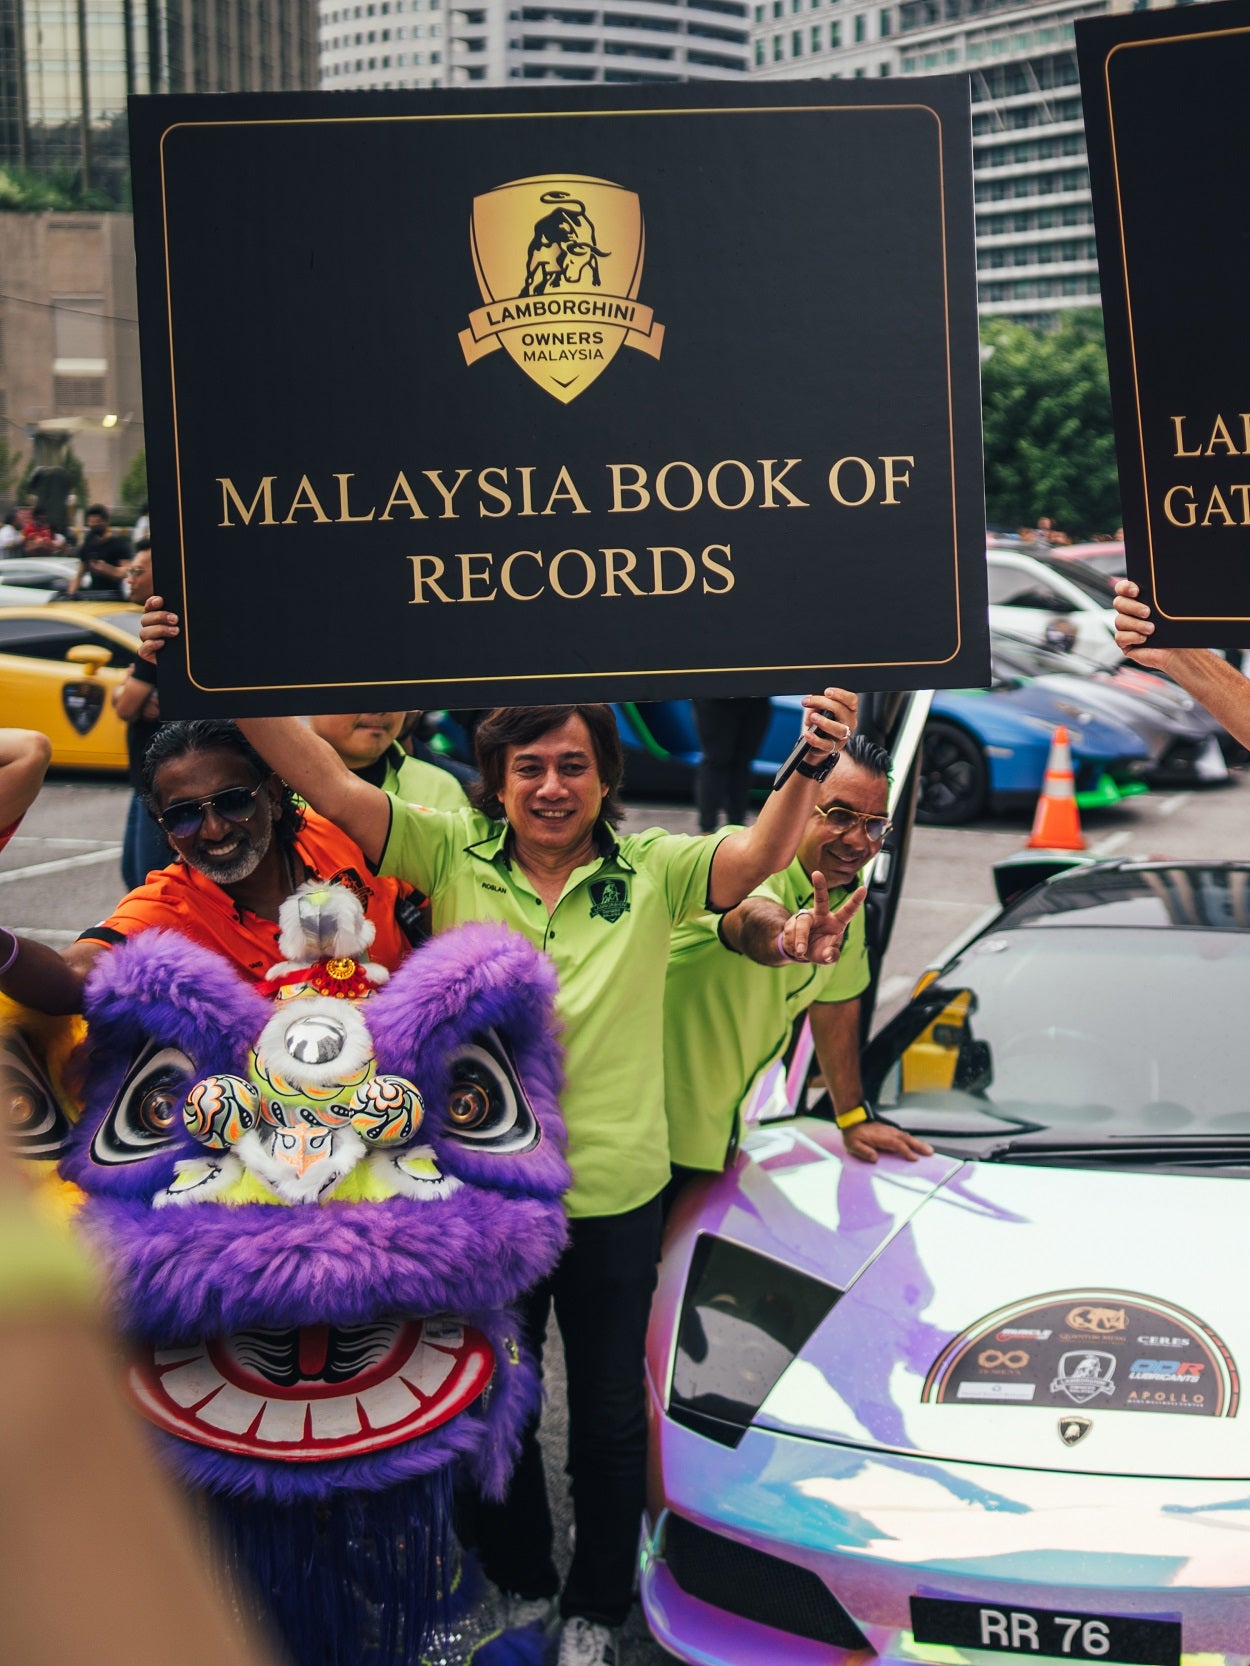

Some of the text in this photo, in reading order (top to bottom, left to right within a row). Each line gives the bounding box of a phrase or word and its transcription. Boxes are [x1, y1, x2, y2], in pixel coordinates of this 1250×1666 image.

[486, 300, 635, 326] LAMBORGHINI
[521, 331, 604, 347] OWNERS
[523, 348, 604, 362] MALAYSIA
[216, 455, 915, 526] MALAYSIA BOOK OF
[407, 544, 735, 604] RECORDS
[1137, 1335, 1190, 1346] CERES
[1128, 1372, 1200, 1383] LUBRICANTS
[1128, 1391, 1204, 1404] APOLLO
[979, 1608, 1110, 1656] RR 76
